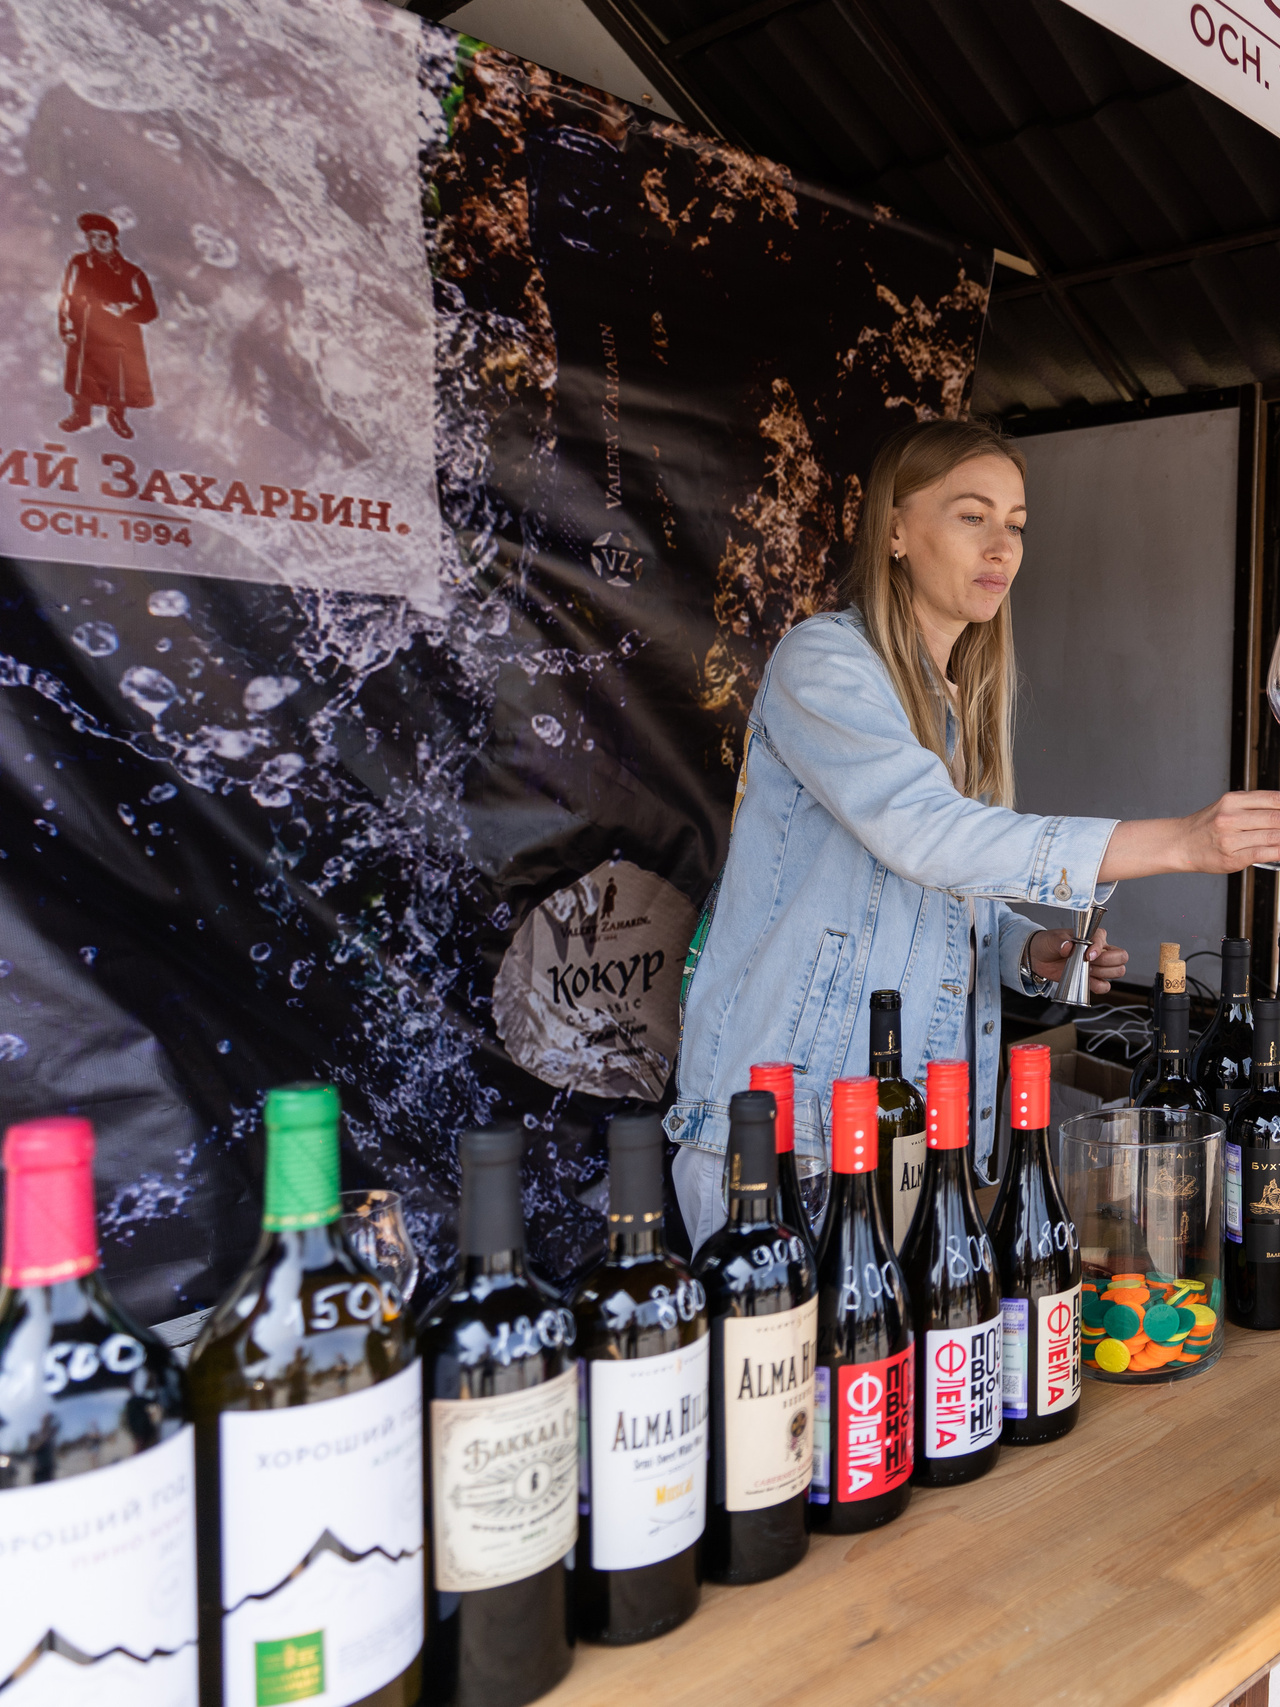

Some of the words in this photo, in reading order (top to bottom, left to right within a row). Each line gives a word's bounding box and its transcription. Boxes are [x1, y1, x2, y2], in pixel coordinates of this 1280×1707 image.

[1190, 4, 1270, 90] ОСН.
[20, 510, 108, 540] ОСН.
[119, 519, 192, 547] 1994
[752, 1235, 805, 1278] 900
[946, 1233, 993, 1279] 800
[1038, 1220, 1079, 1258] 800
[650, 1278, 706, 1330] 800
[843, 1261, 900, 1311] 800
[738, 1357, 797, 1401] ALMA
[612, 1410, 675, 1452] ALMA
